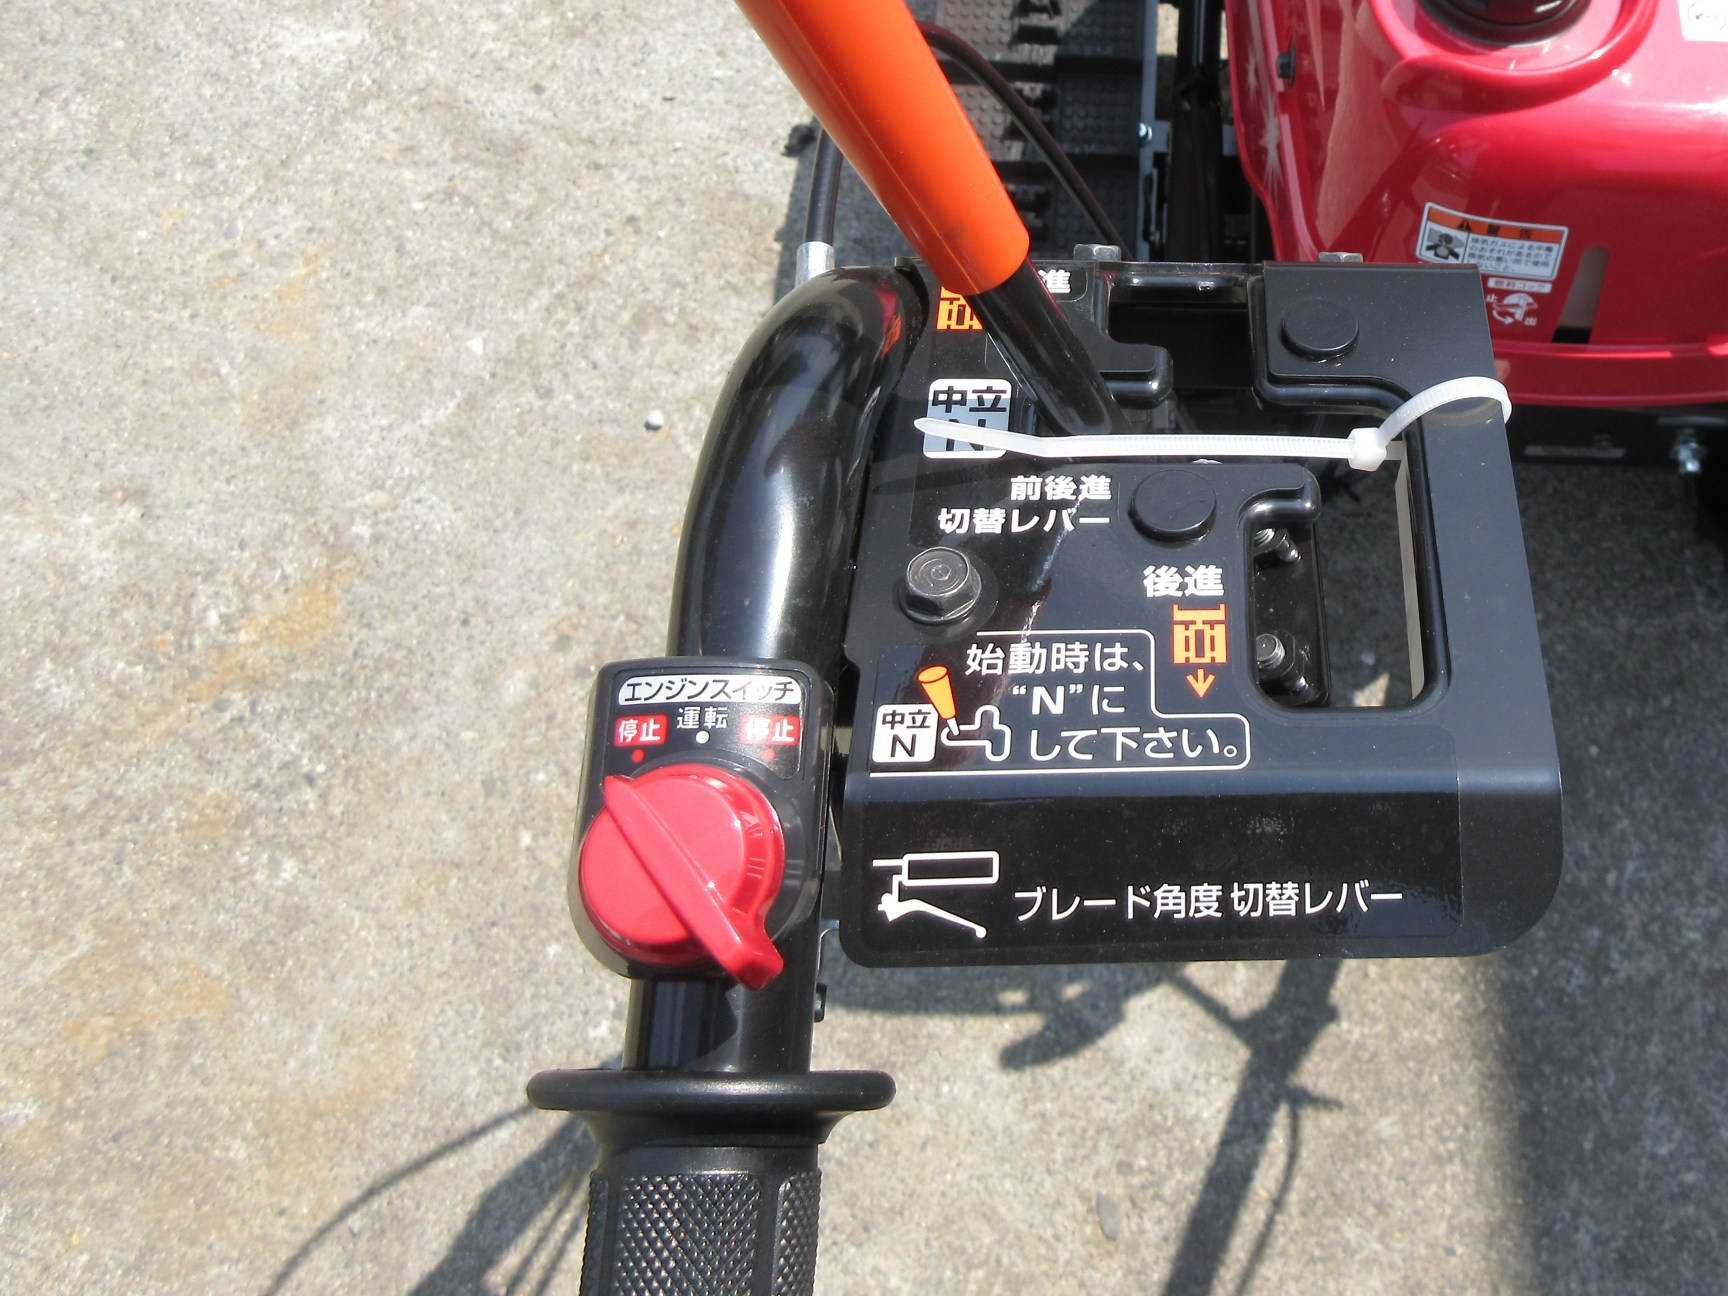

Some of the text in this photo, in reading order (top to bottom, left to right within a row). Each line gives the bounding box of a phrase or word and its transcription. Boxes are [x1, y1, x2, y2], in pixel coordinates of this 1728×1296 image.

[1037, 269, 1071, 294] 進
[931, 385, 1008, 414] 中立
[1010, 474, 1112, 501] 前後進
[938, 507, 1110, 534] 切替レバー
[1142, 564, 1225, 597] 後進
[964, 641, 1146, 676] 始動時は、
[624, 677, 795, 702] エンジンスイッチ
[618, 706, 796, 743] 停止 運転 停止
[881, 709, 932, 731] 中立
[890, 734, 917, 758] N
[1029, 727, 1238, 762] して下さい。
